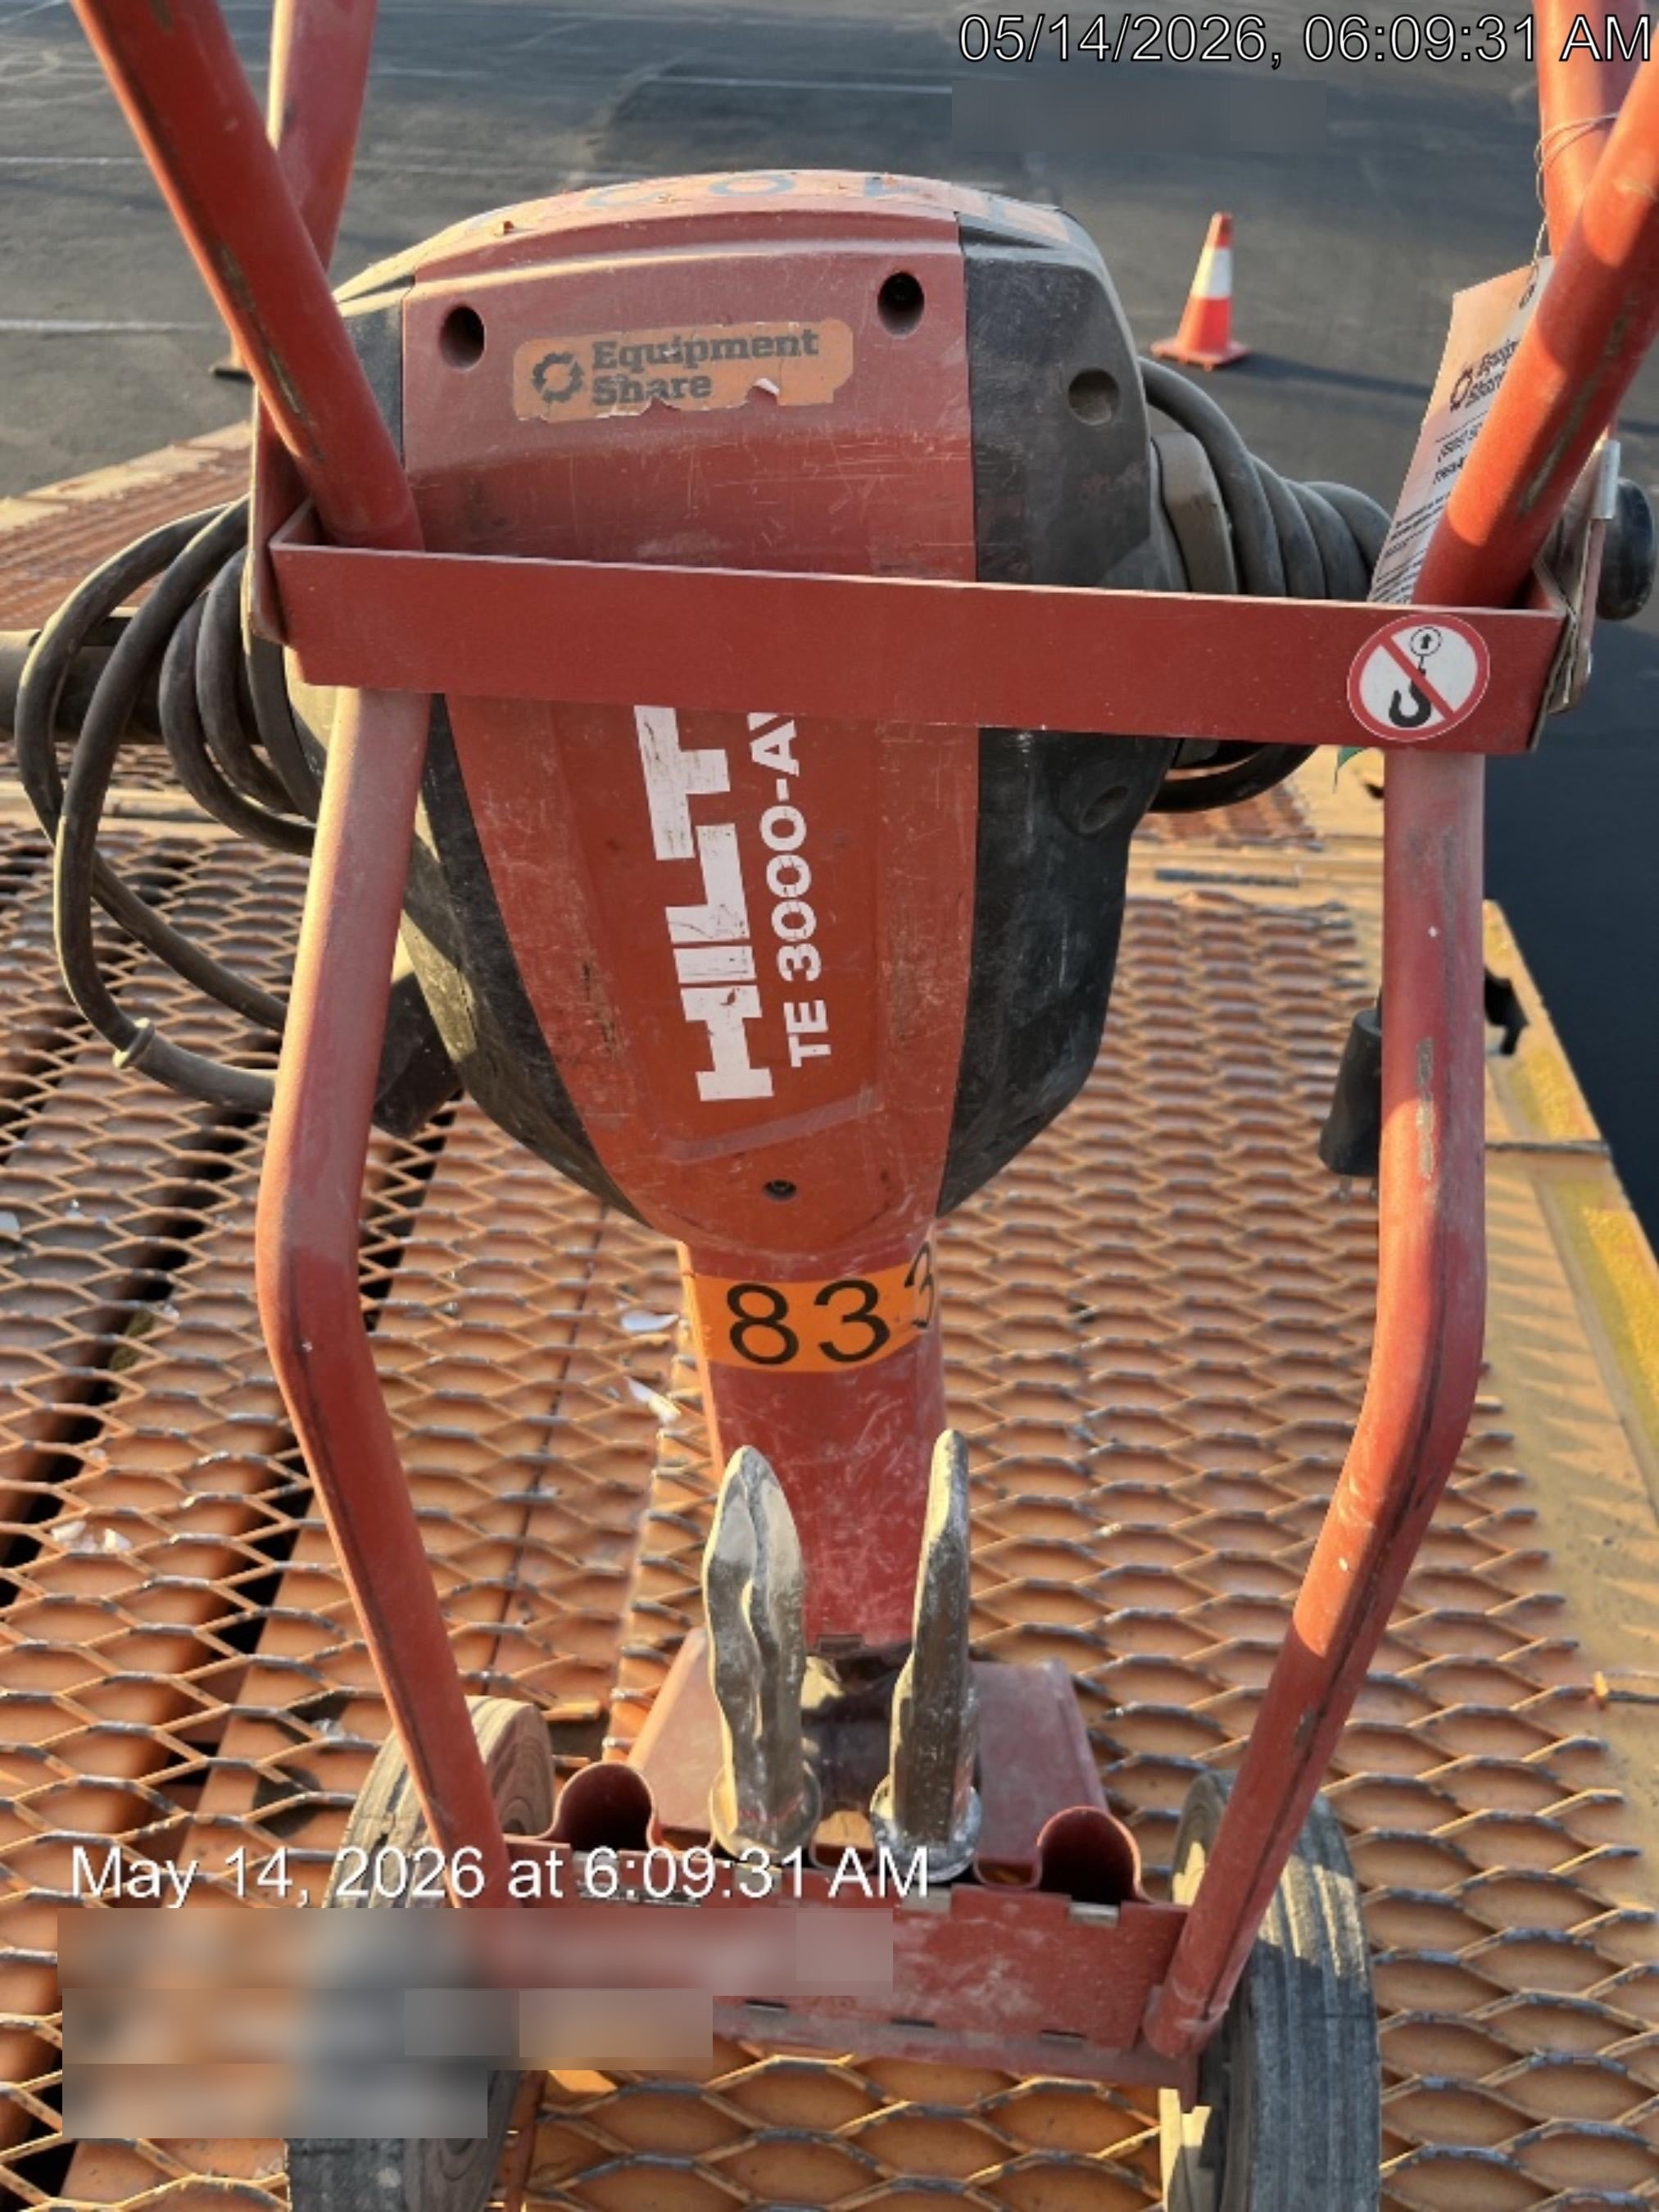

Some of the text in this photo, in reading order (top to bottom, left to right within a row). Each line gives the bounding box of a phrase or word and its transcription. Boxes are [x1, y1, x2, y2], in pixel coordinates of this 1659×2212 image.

[592, 329, 819, 371] Equipment
[592, 374, 712, 406] Share
[783, 999, 832, 1067] TE
